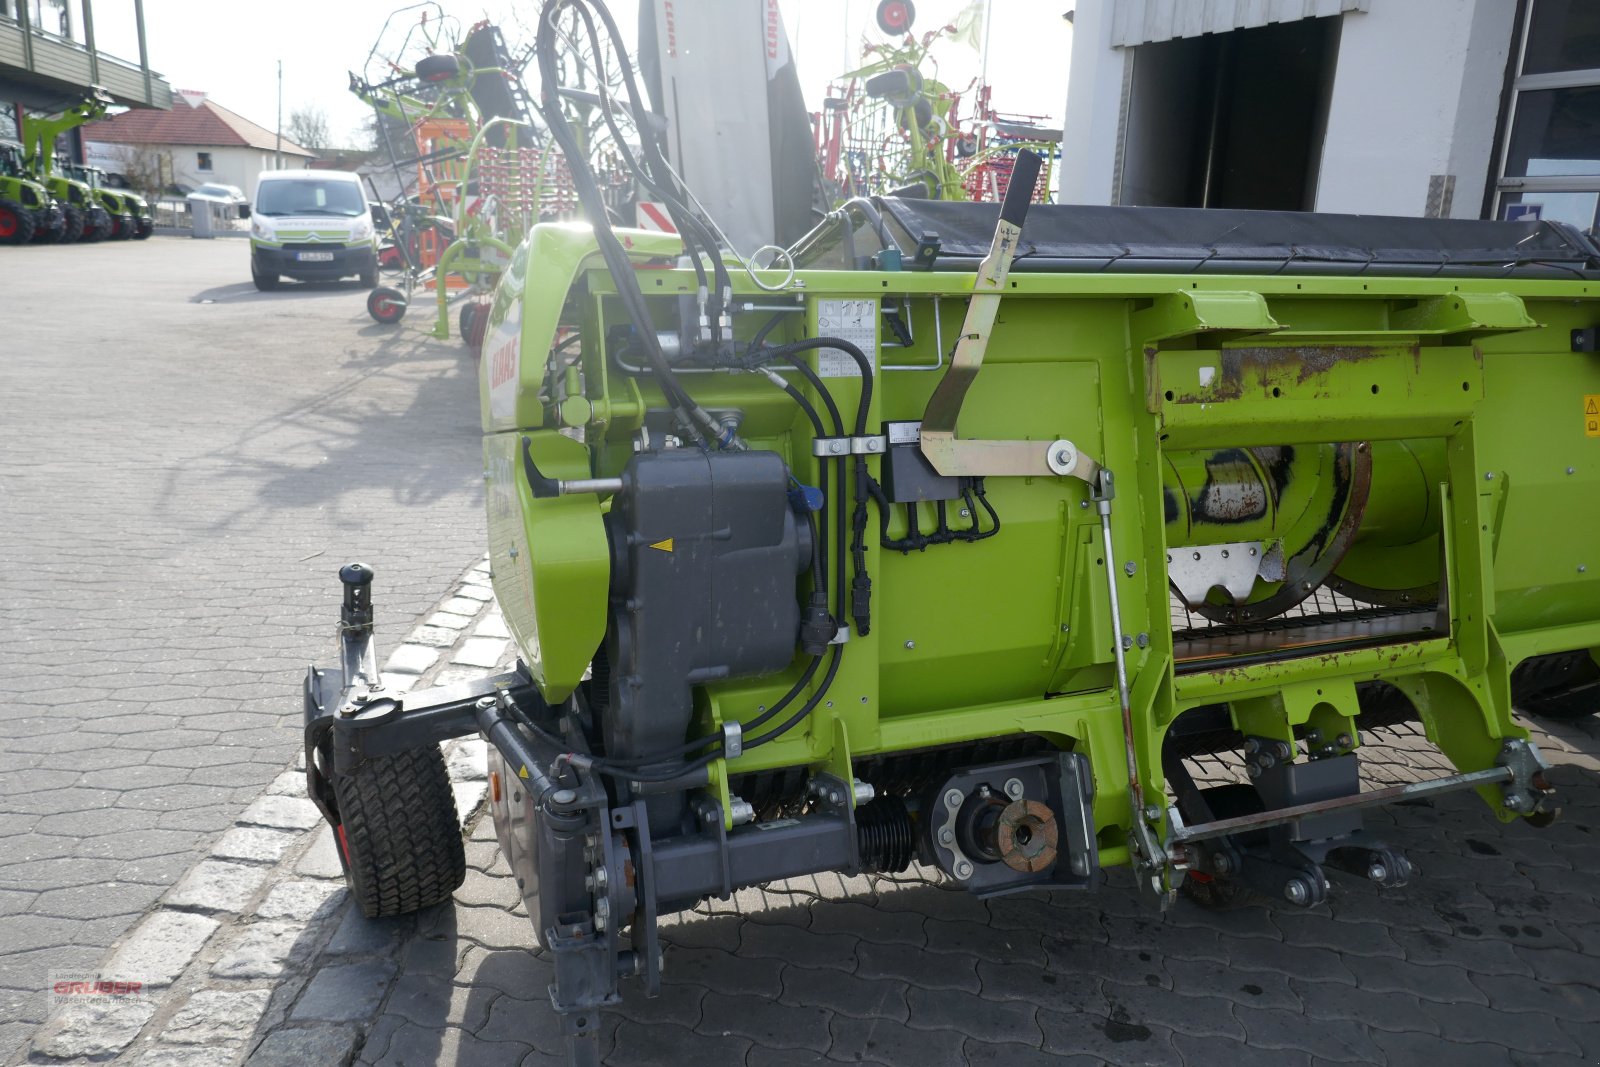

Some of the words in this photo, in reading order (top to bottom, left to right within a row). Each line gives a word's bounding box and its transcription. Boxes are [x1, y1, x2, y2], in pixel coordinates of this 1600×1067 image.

[664, 1, 676, 58] CLAAS
[768, 0, 777, 58] CLAAS
[492, 337, 516, 390] CLAAS
